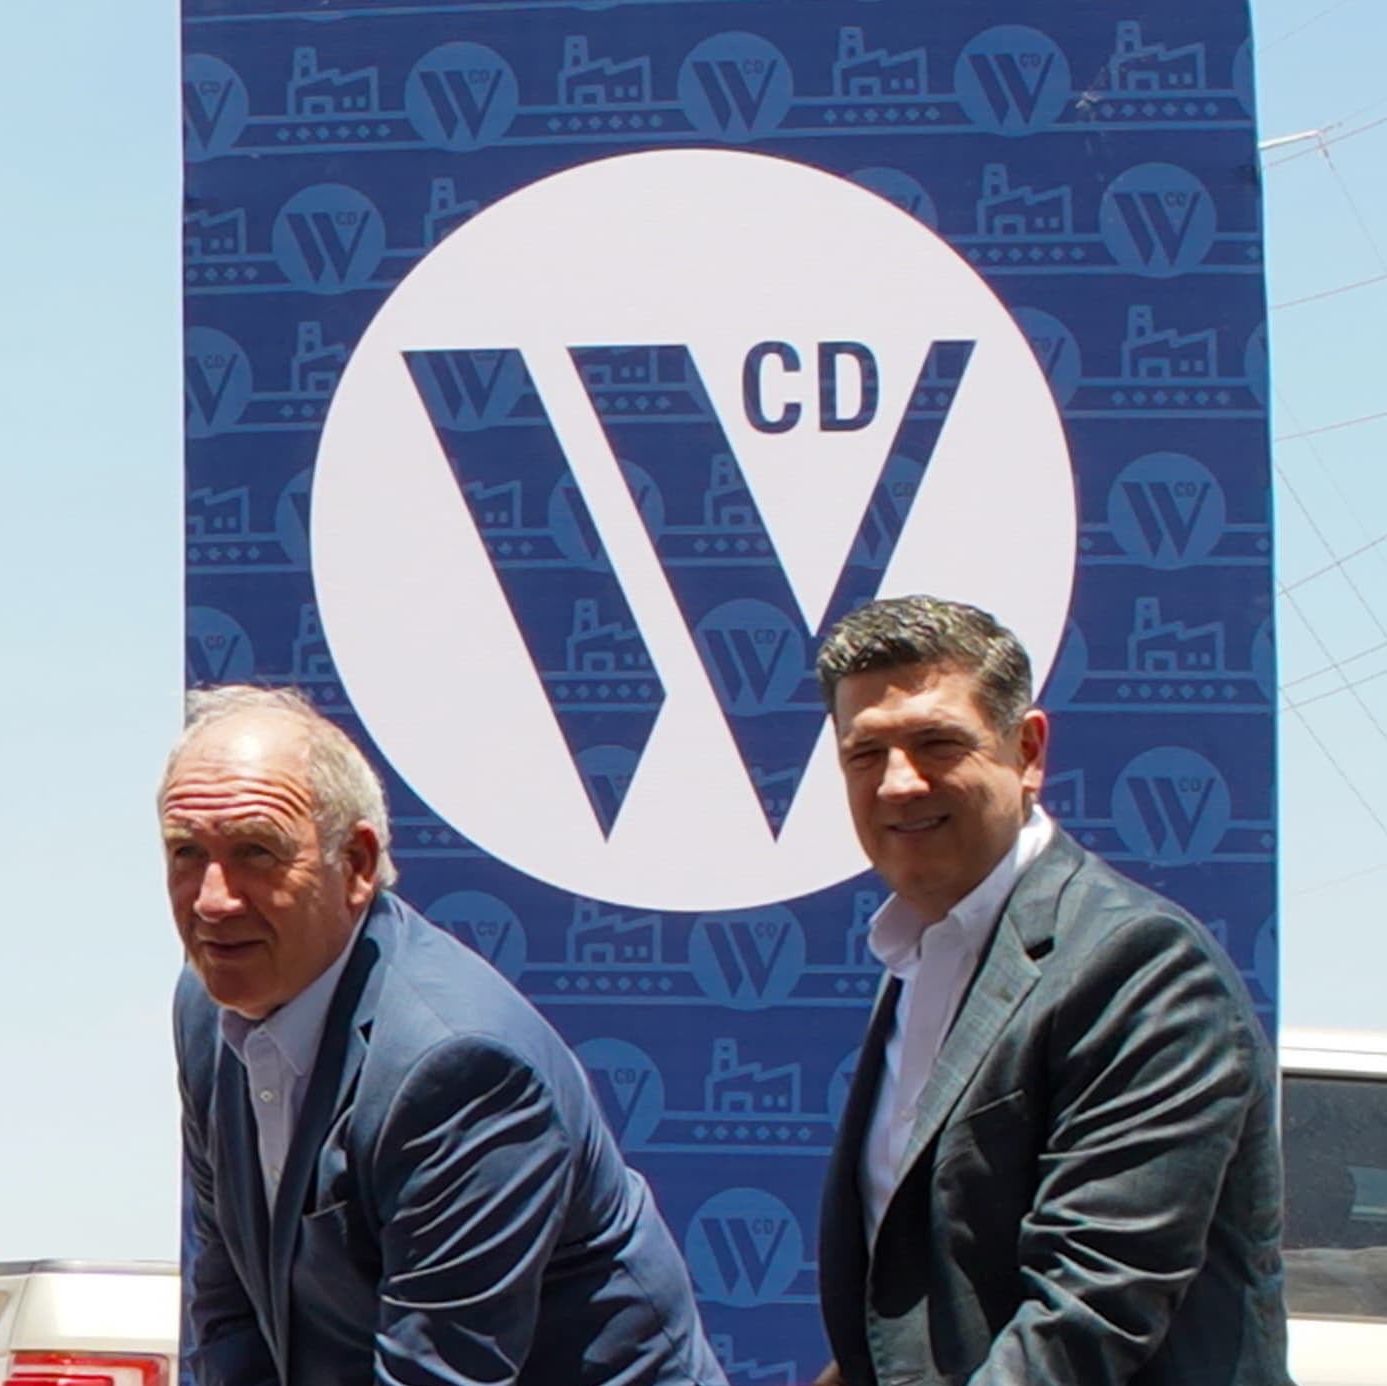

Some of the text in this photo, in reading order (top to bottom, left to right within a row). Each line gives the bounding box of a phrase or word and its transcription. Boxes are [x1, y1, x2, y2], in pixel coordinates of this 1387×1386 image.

[419, 69, 503, 140] W
[692, 60, 777, 131] W
[969, 53, 1055, 125] W
[286, 211, 370, 284] W
[1113, 192, 1200, 266] W
[1121, 482, 1211, 557] W
[401, 339, 977, 843] W CD
[702, 629, 791, 704] W
[1127, 776, 1215, 854] W
[703, 922, 791, 998] W
[701, 1218, 789, 1296] W
